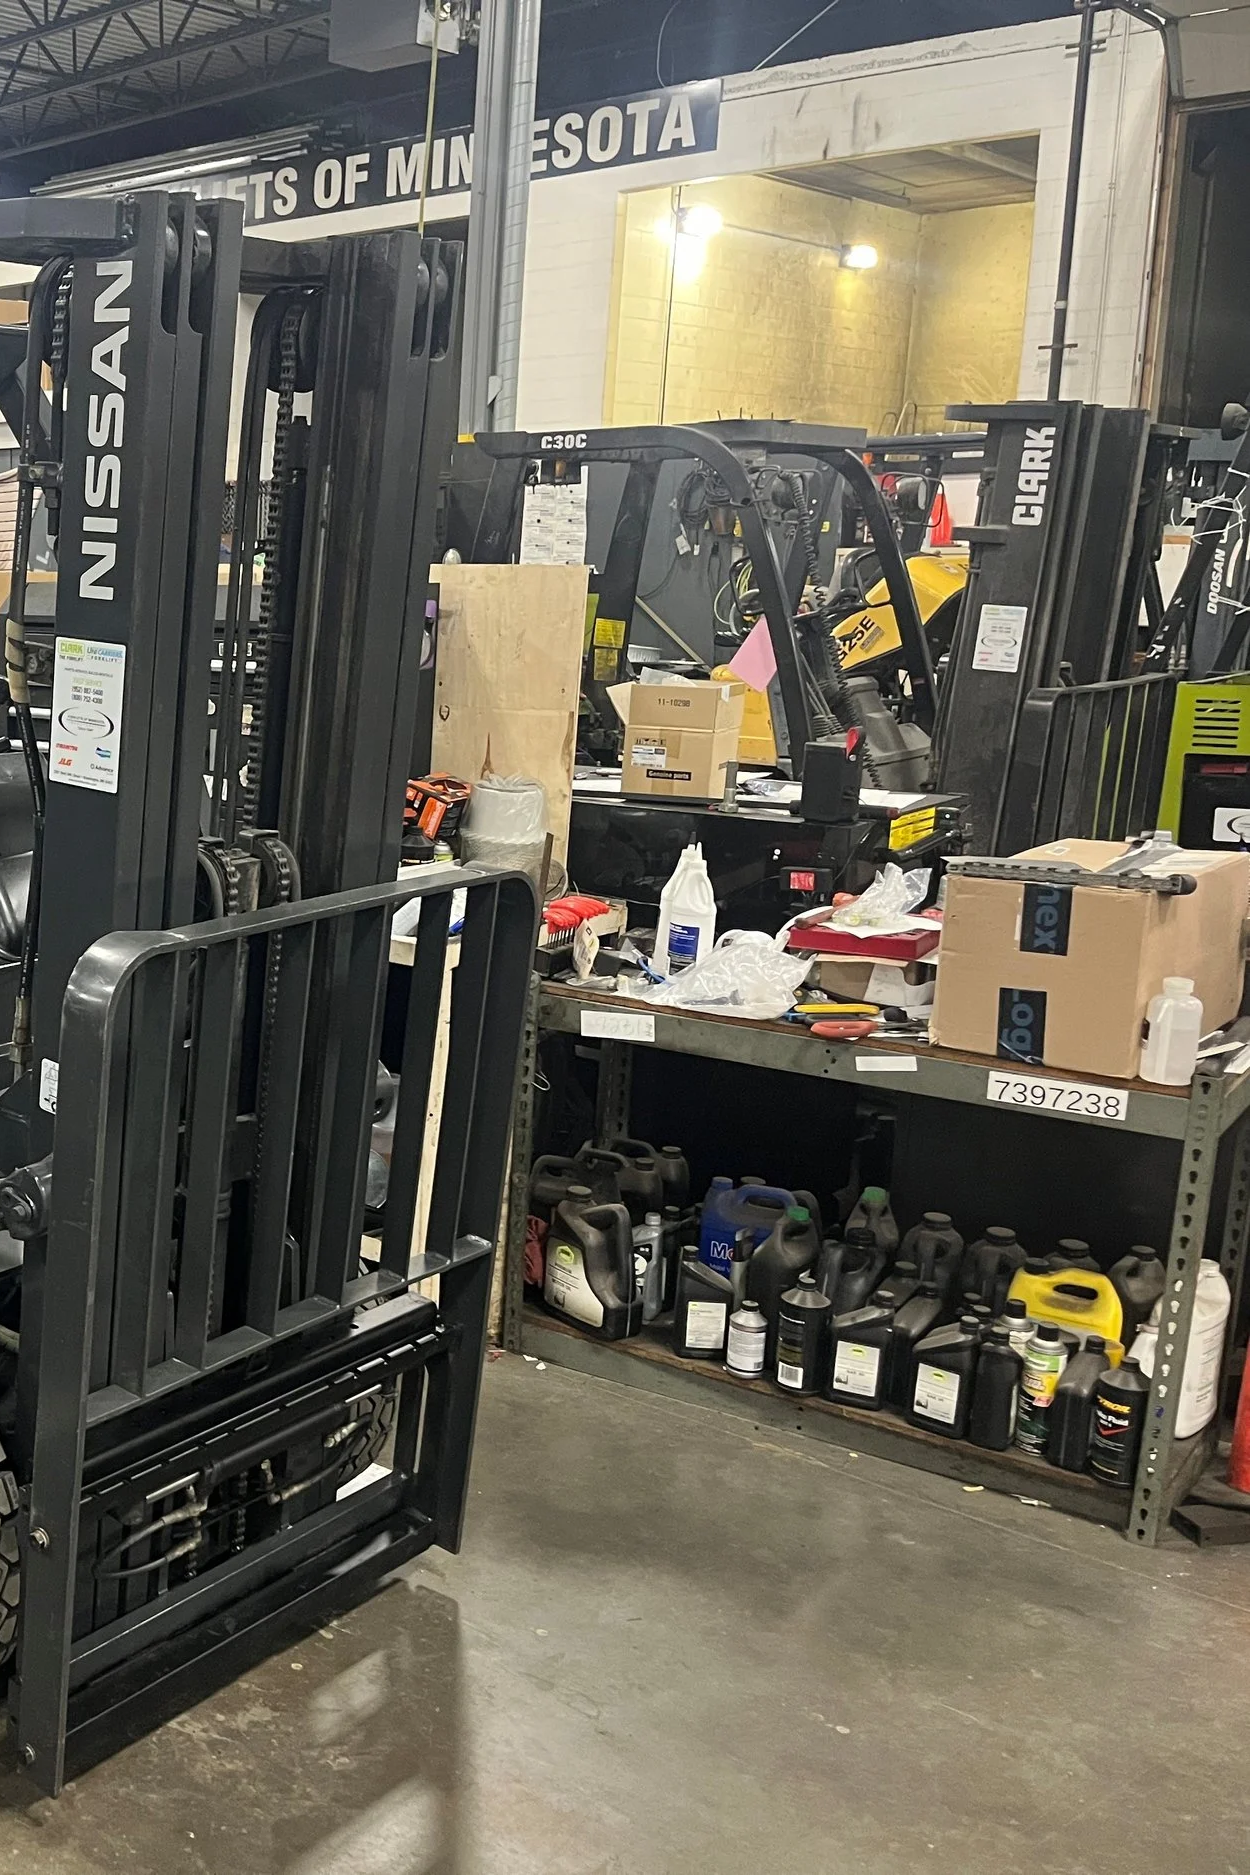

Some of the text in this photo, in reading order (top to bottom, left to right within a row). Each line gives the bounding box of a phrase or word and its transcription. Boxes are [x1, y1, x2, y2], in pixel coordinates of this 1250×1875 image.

[313, 153, 369, 209] OF
[385, 94, 697, 198] MINESOTA
[79, 260, 133, 601] NISSAN
[541, 433, 587, 450] C30C
[1011, 426, 1057, 526] CLARK
[1206, 548, 1226, 615] DOOSAN
[60, 643, 83, 654] CLARK
[58, 758, 72, 766] JLG
[648, 770, 689, 780] Genuine parts
[994, 1079, 1120, 1117] 7397238
